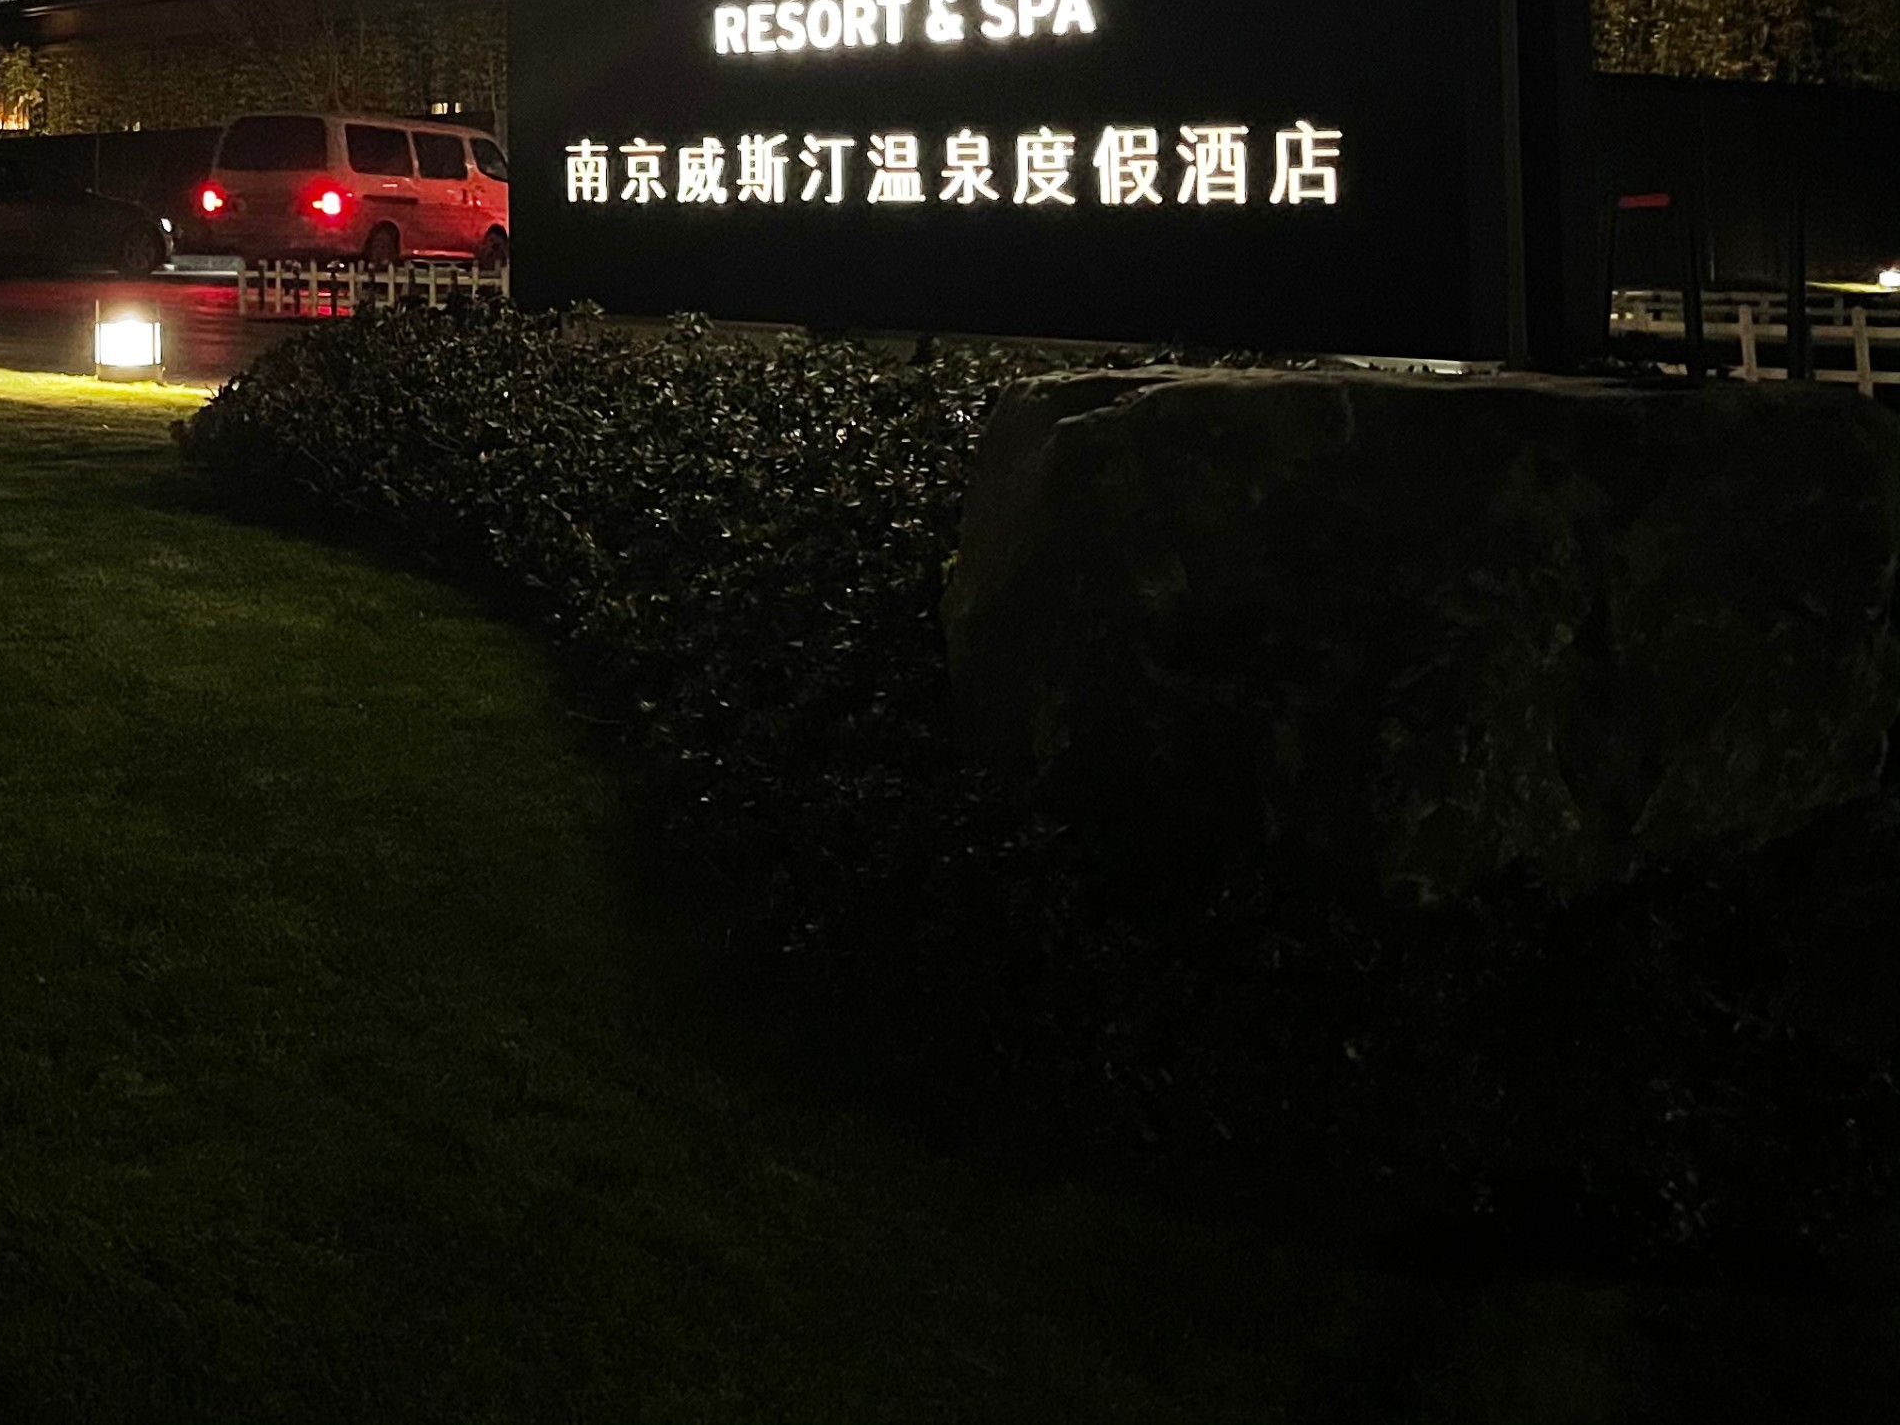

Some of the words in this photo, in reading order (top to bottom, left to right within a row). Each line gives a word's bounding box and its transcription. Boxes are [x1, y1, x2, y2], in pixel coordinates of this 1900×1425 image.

[564, 120, 1343, 205] 南京威斯汀温泉度假酒店
